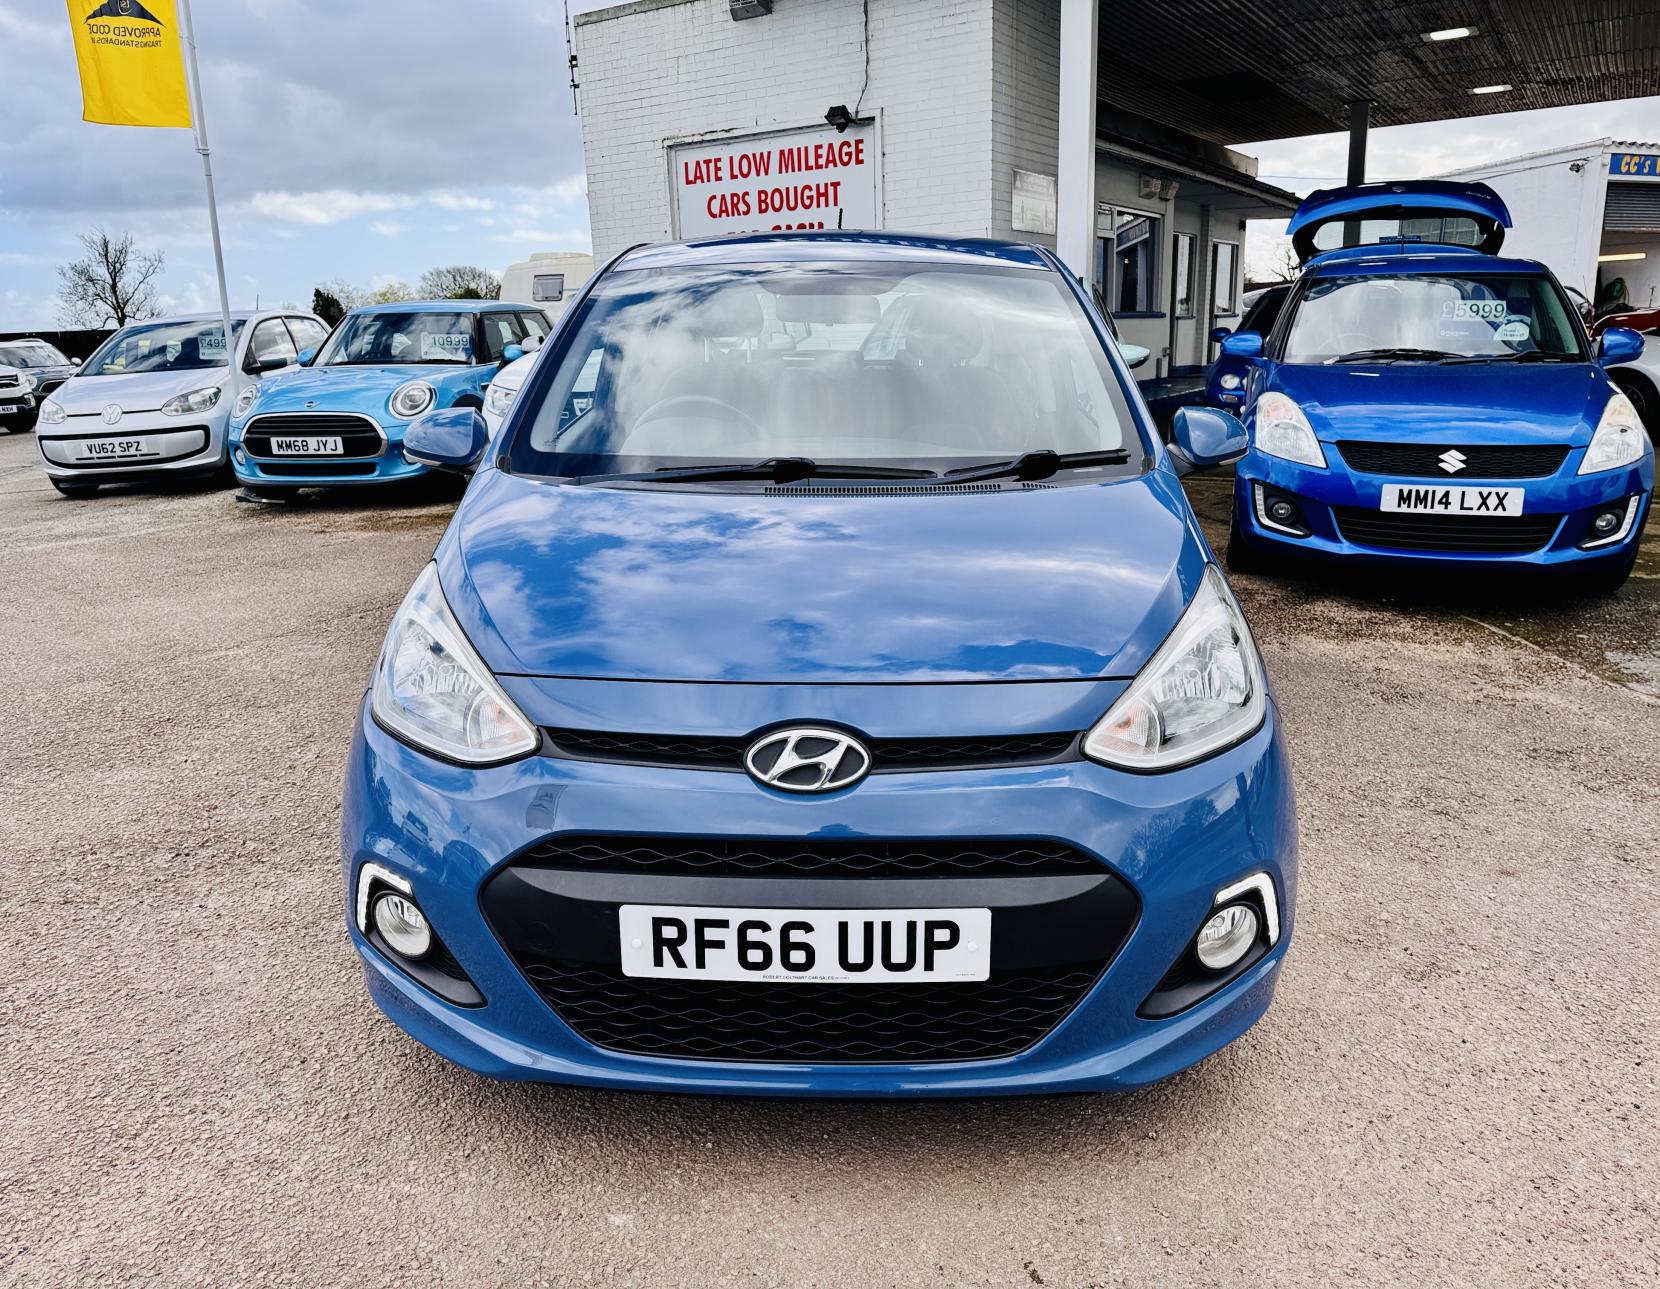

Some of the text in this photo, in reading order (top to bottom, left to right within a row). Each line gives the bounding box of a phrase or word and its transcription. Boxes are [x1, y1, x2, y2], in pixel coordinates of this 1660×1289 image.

[684, 138, 865, 185] LATE LOW MILEAGE
[1620, 154, 1651, 174] CC's
[707, 181, 841, 219] CARS BOUGHT
[200, 338, 228, 348] £499
[86, 440, 142, 454] VU62 SPZ
[276, 439, 338, 452] MM68 JYJ
[1397, 488, 1509, 512] MM14 LXX
[651, 916, 961, 972] RF66 UUP
